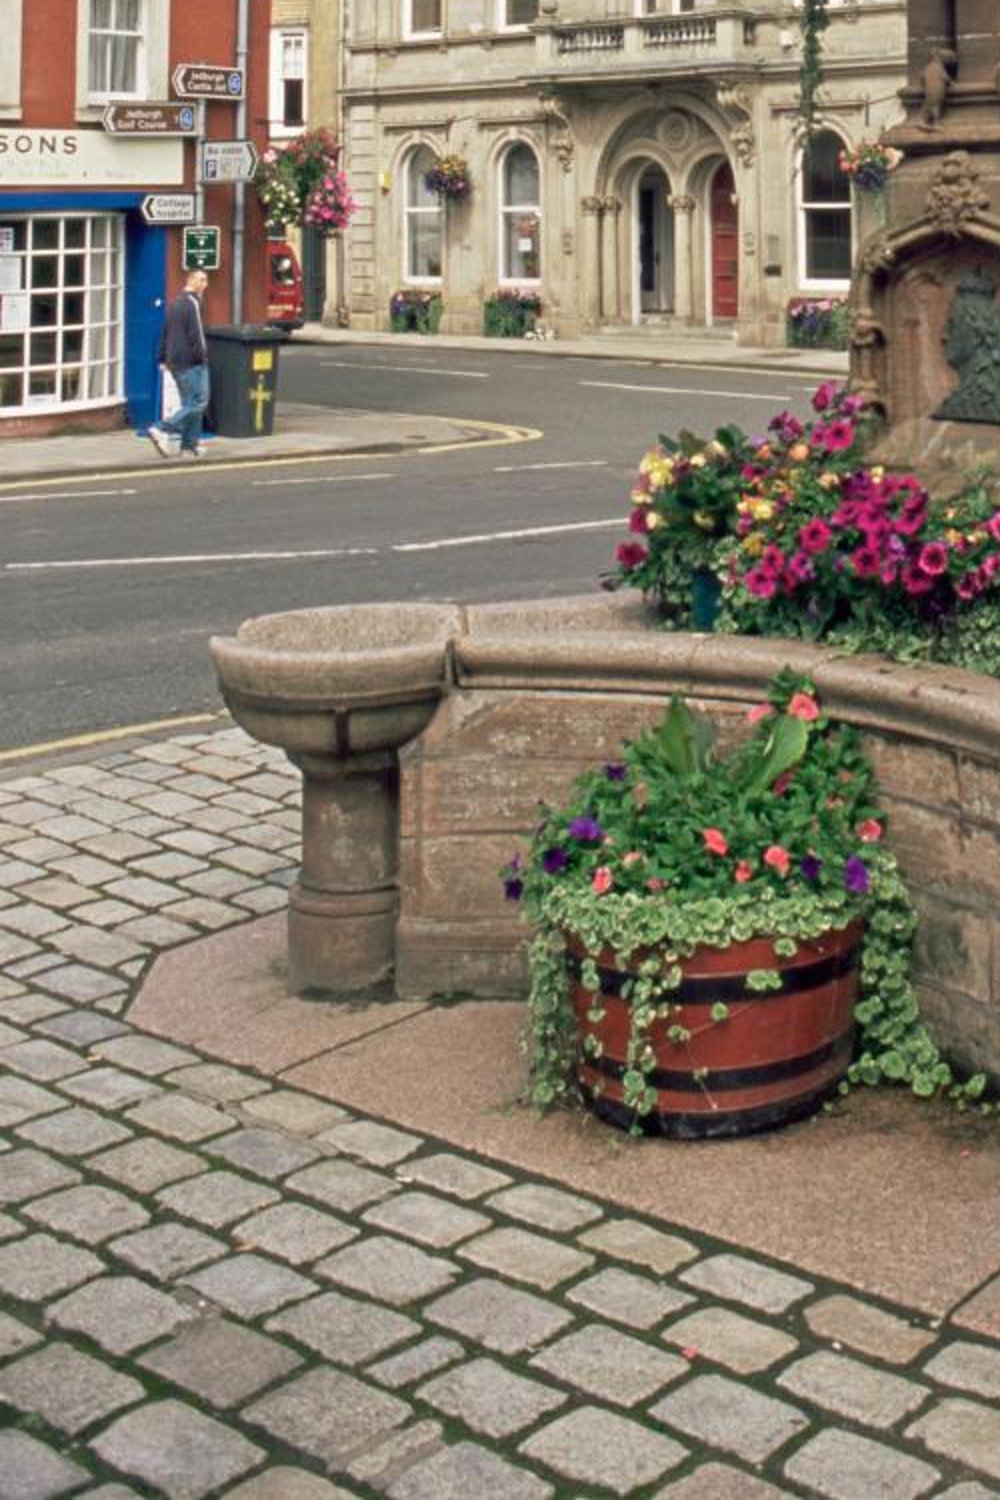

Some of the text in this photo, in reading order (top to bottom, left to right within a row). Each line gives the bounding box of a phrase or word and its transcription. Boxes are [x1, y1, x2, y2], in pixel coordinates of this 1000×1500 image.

[191, 71, 225, 81] Jedburgh
[187, 81, 212, 91] Castle
[125, 109, 163, 120] Jedburgh
[138, 119, 168, 130] Course
[156, 199, 191, 209] Cottage
[156, 209, 191, 218] hospital
